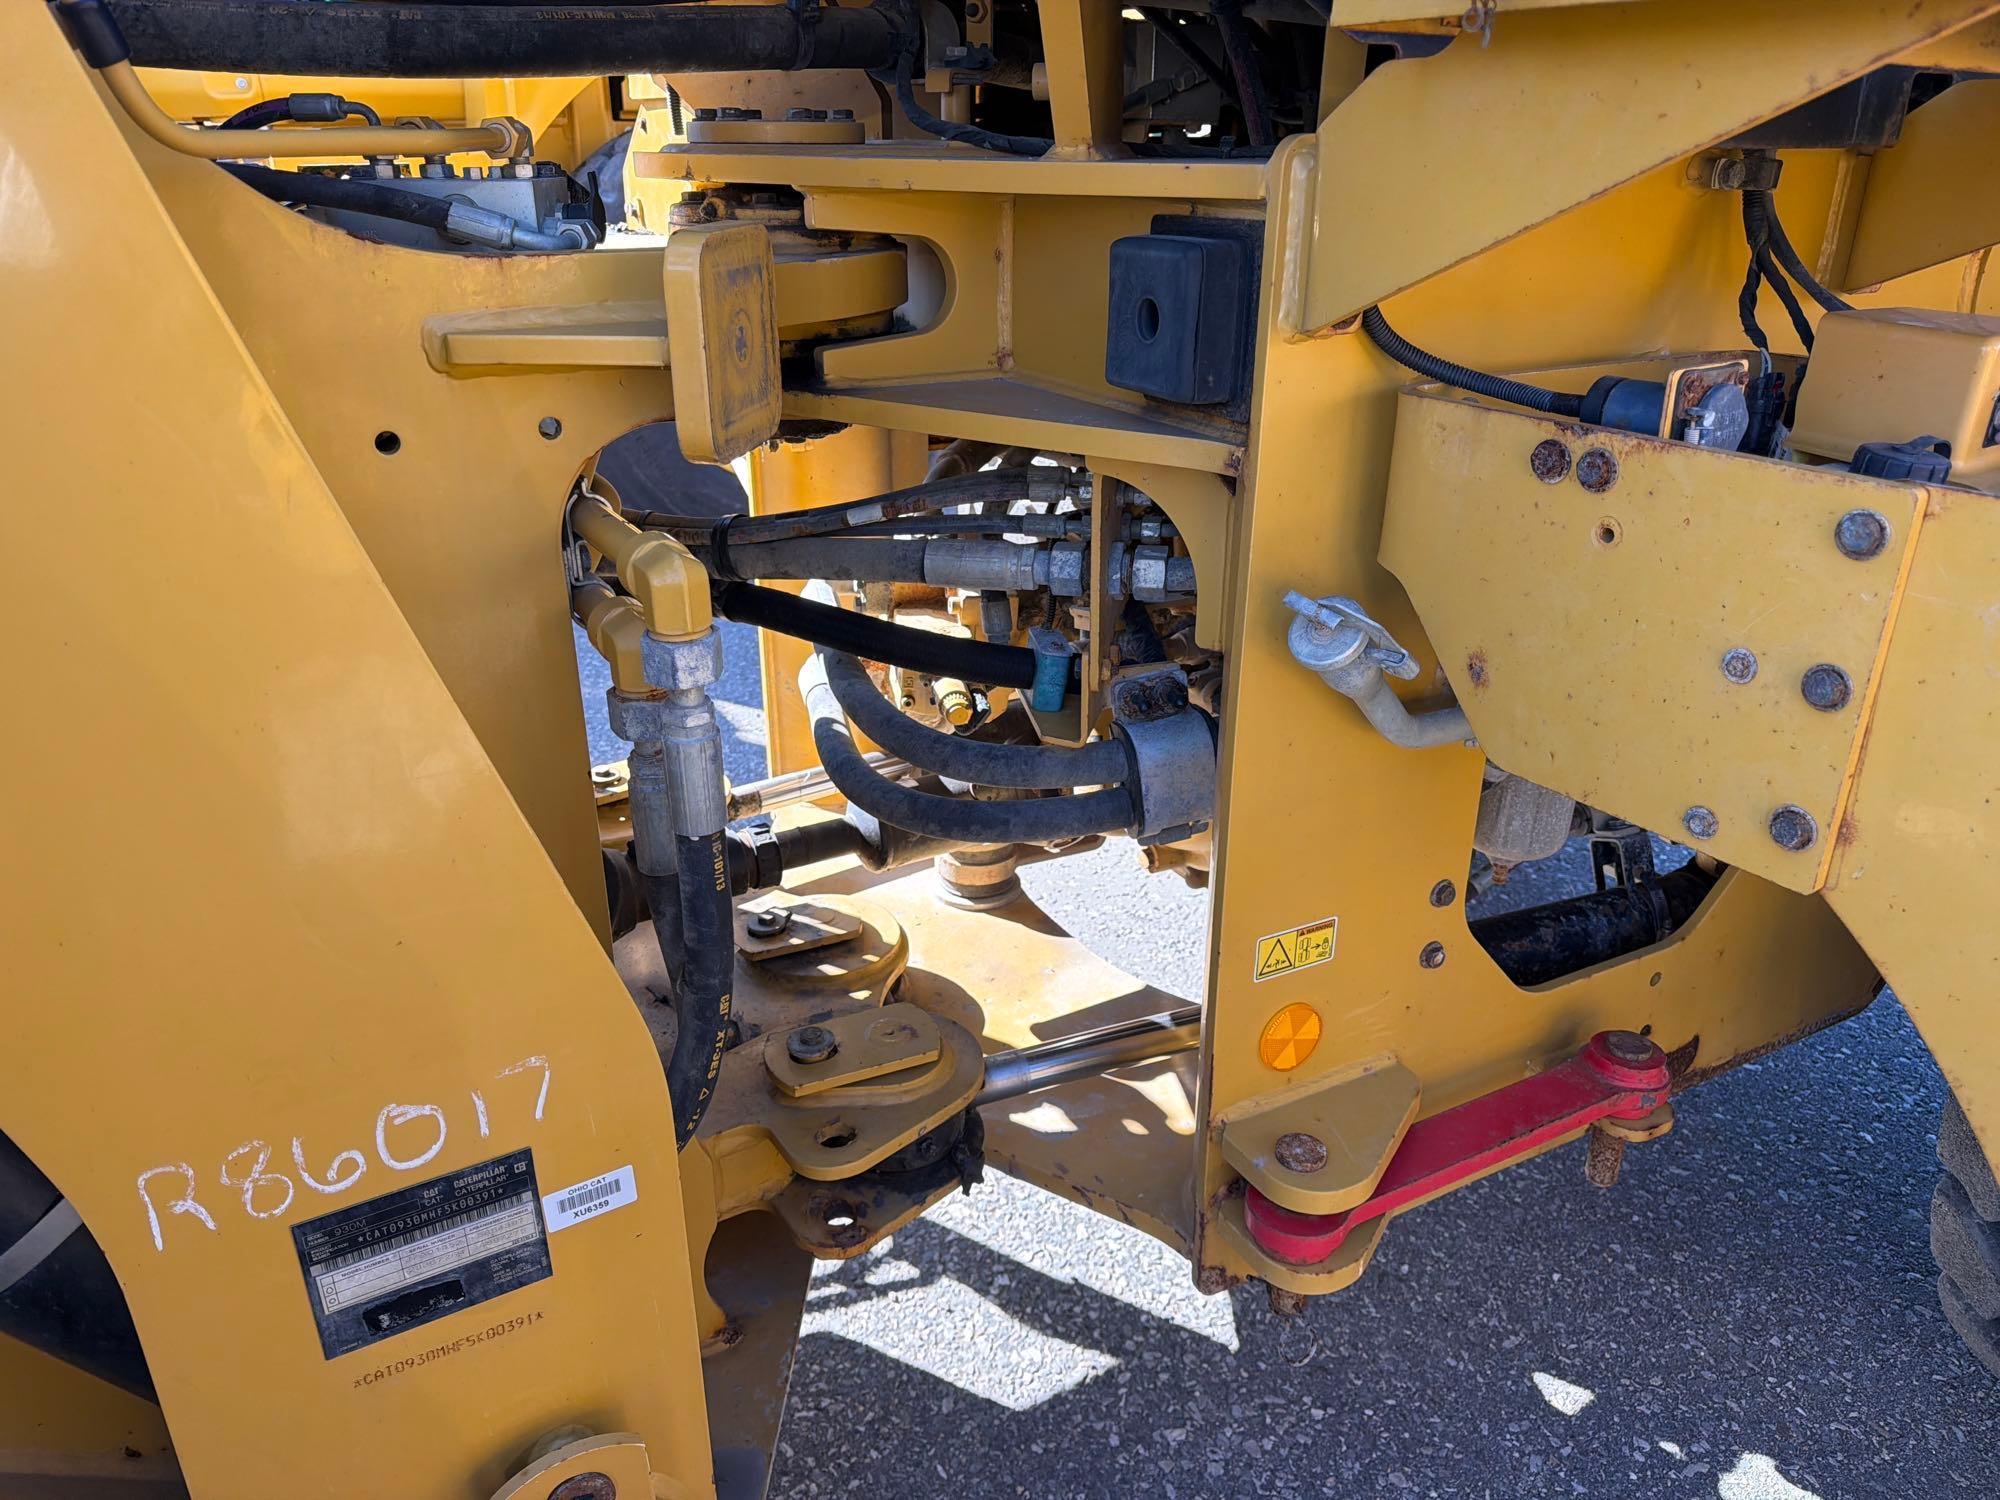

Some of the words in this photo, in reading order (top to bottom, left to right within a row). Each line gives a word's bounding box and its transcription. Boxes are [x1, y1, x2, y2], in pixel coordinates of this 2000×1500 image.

[1306, 922, 1333, 935] WARNING
[719, 994, 730, 1016] CAT
[707, 1030, 726, 1080] XT-3ES
[137, 1055, 551, 1252] R86017
[453, 1166, 505, 1187] CATERPILLAR
[455, 1174, 509, 1197] CATERPILLAR
[568, 1183, 589, 1196] OHIO
[590, 1176, 607, 1188] CAT
[573, 1199, 609, 1219] XU6359
[334, 1219, 367, 1236] 930M
